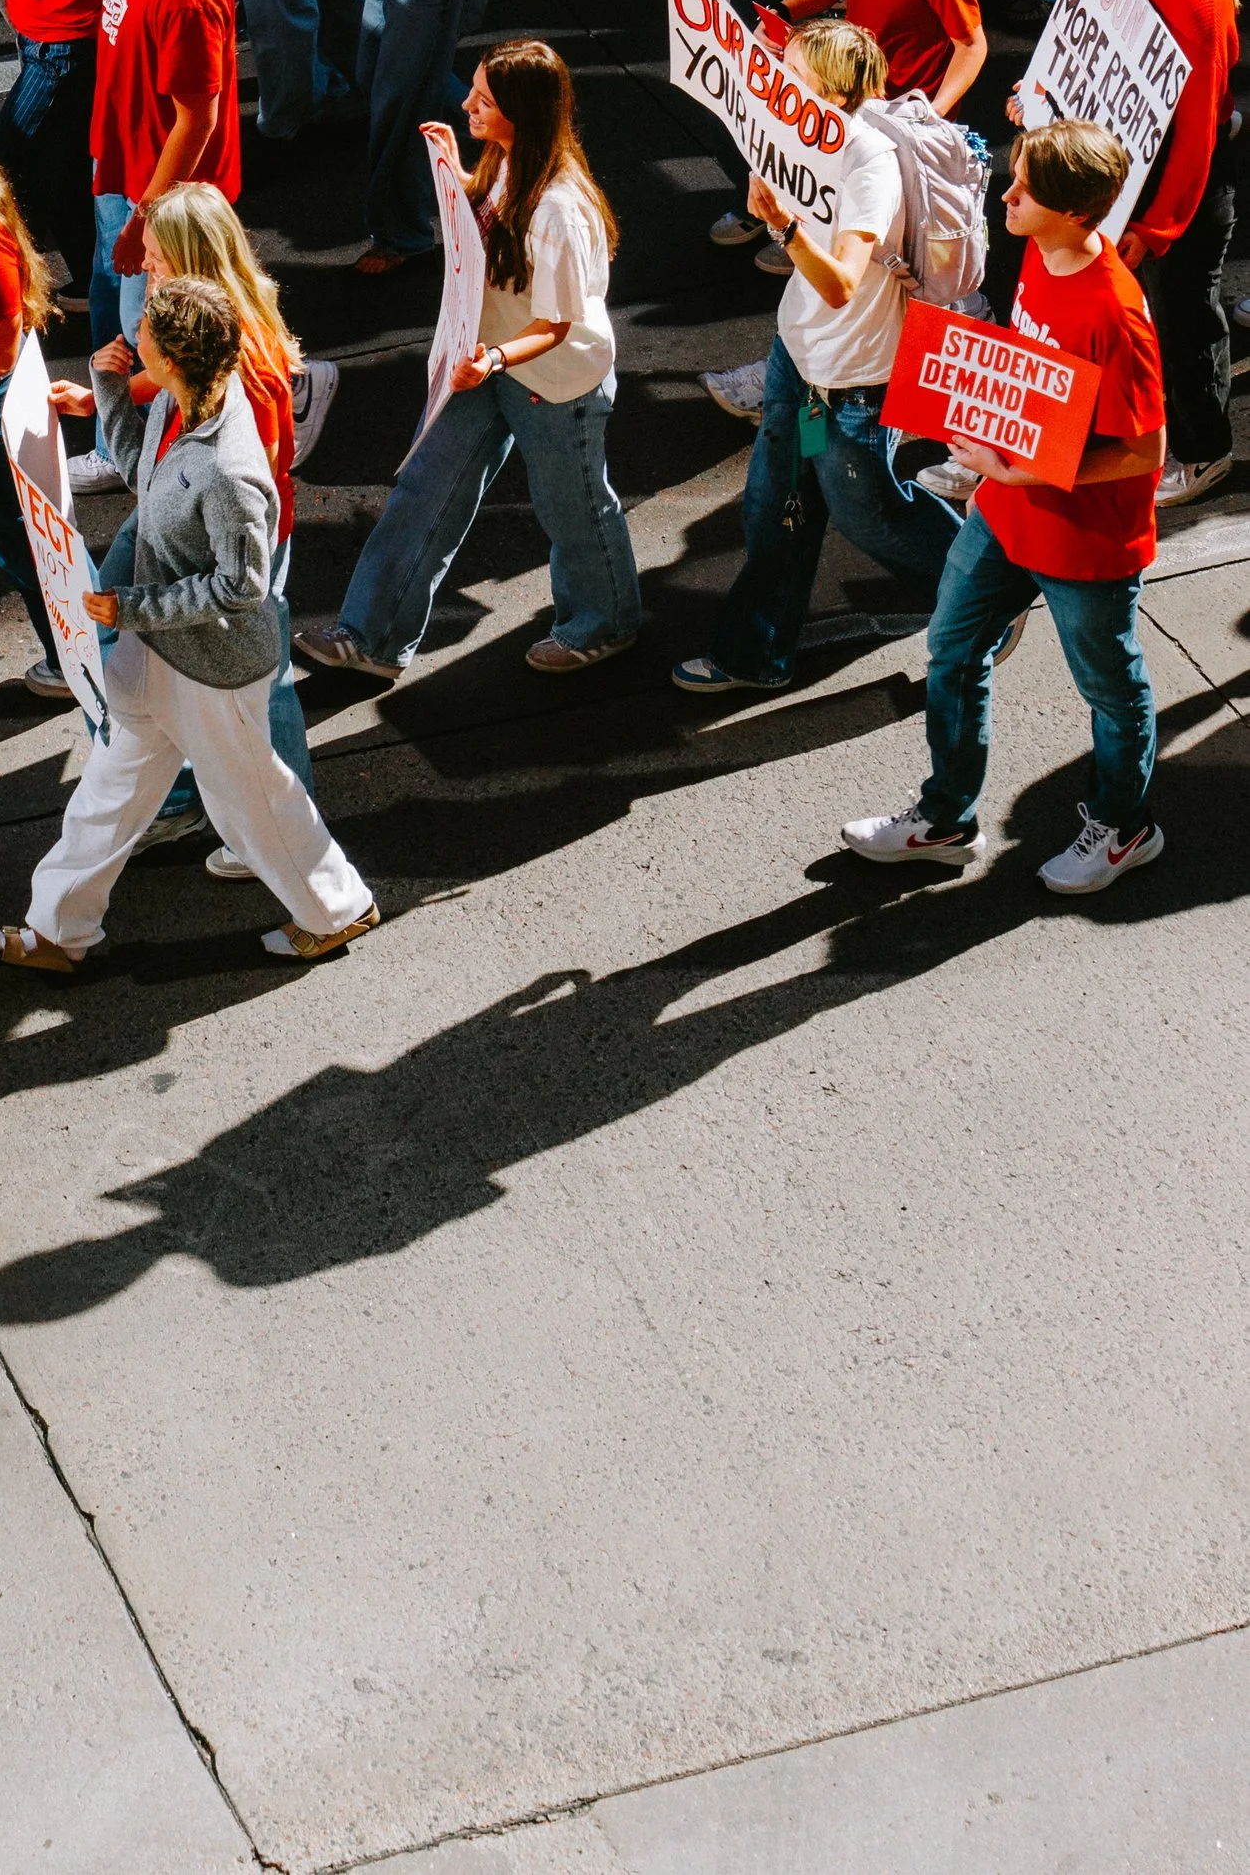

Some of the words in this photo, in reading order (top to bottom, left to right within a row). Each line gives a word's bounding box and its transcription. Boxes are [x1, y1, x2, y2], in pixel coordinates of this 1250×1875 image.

[747, 44, 846, 154] BLOOD
[1048, 35, 1101, 121] THAN
[1098, 51, 1162, 166] RIGHTS
[1139, 21, 1186, 111] HAS
[675, 27, 747, 145] YOUR
[749, 118, 836, 225] HANDS
[922, 357, 1022, 413] DEMAND
[944, 330, 1070, 397] STUDENTS
[949, 400, 1037, 455] ACTION
[36, 539, 70, 587] NOT
